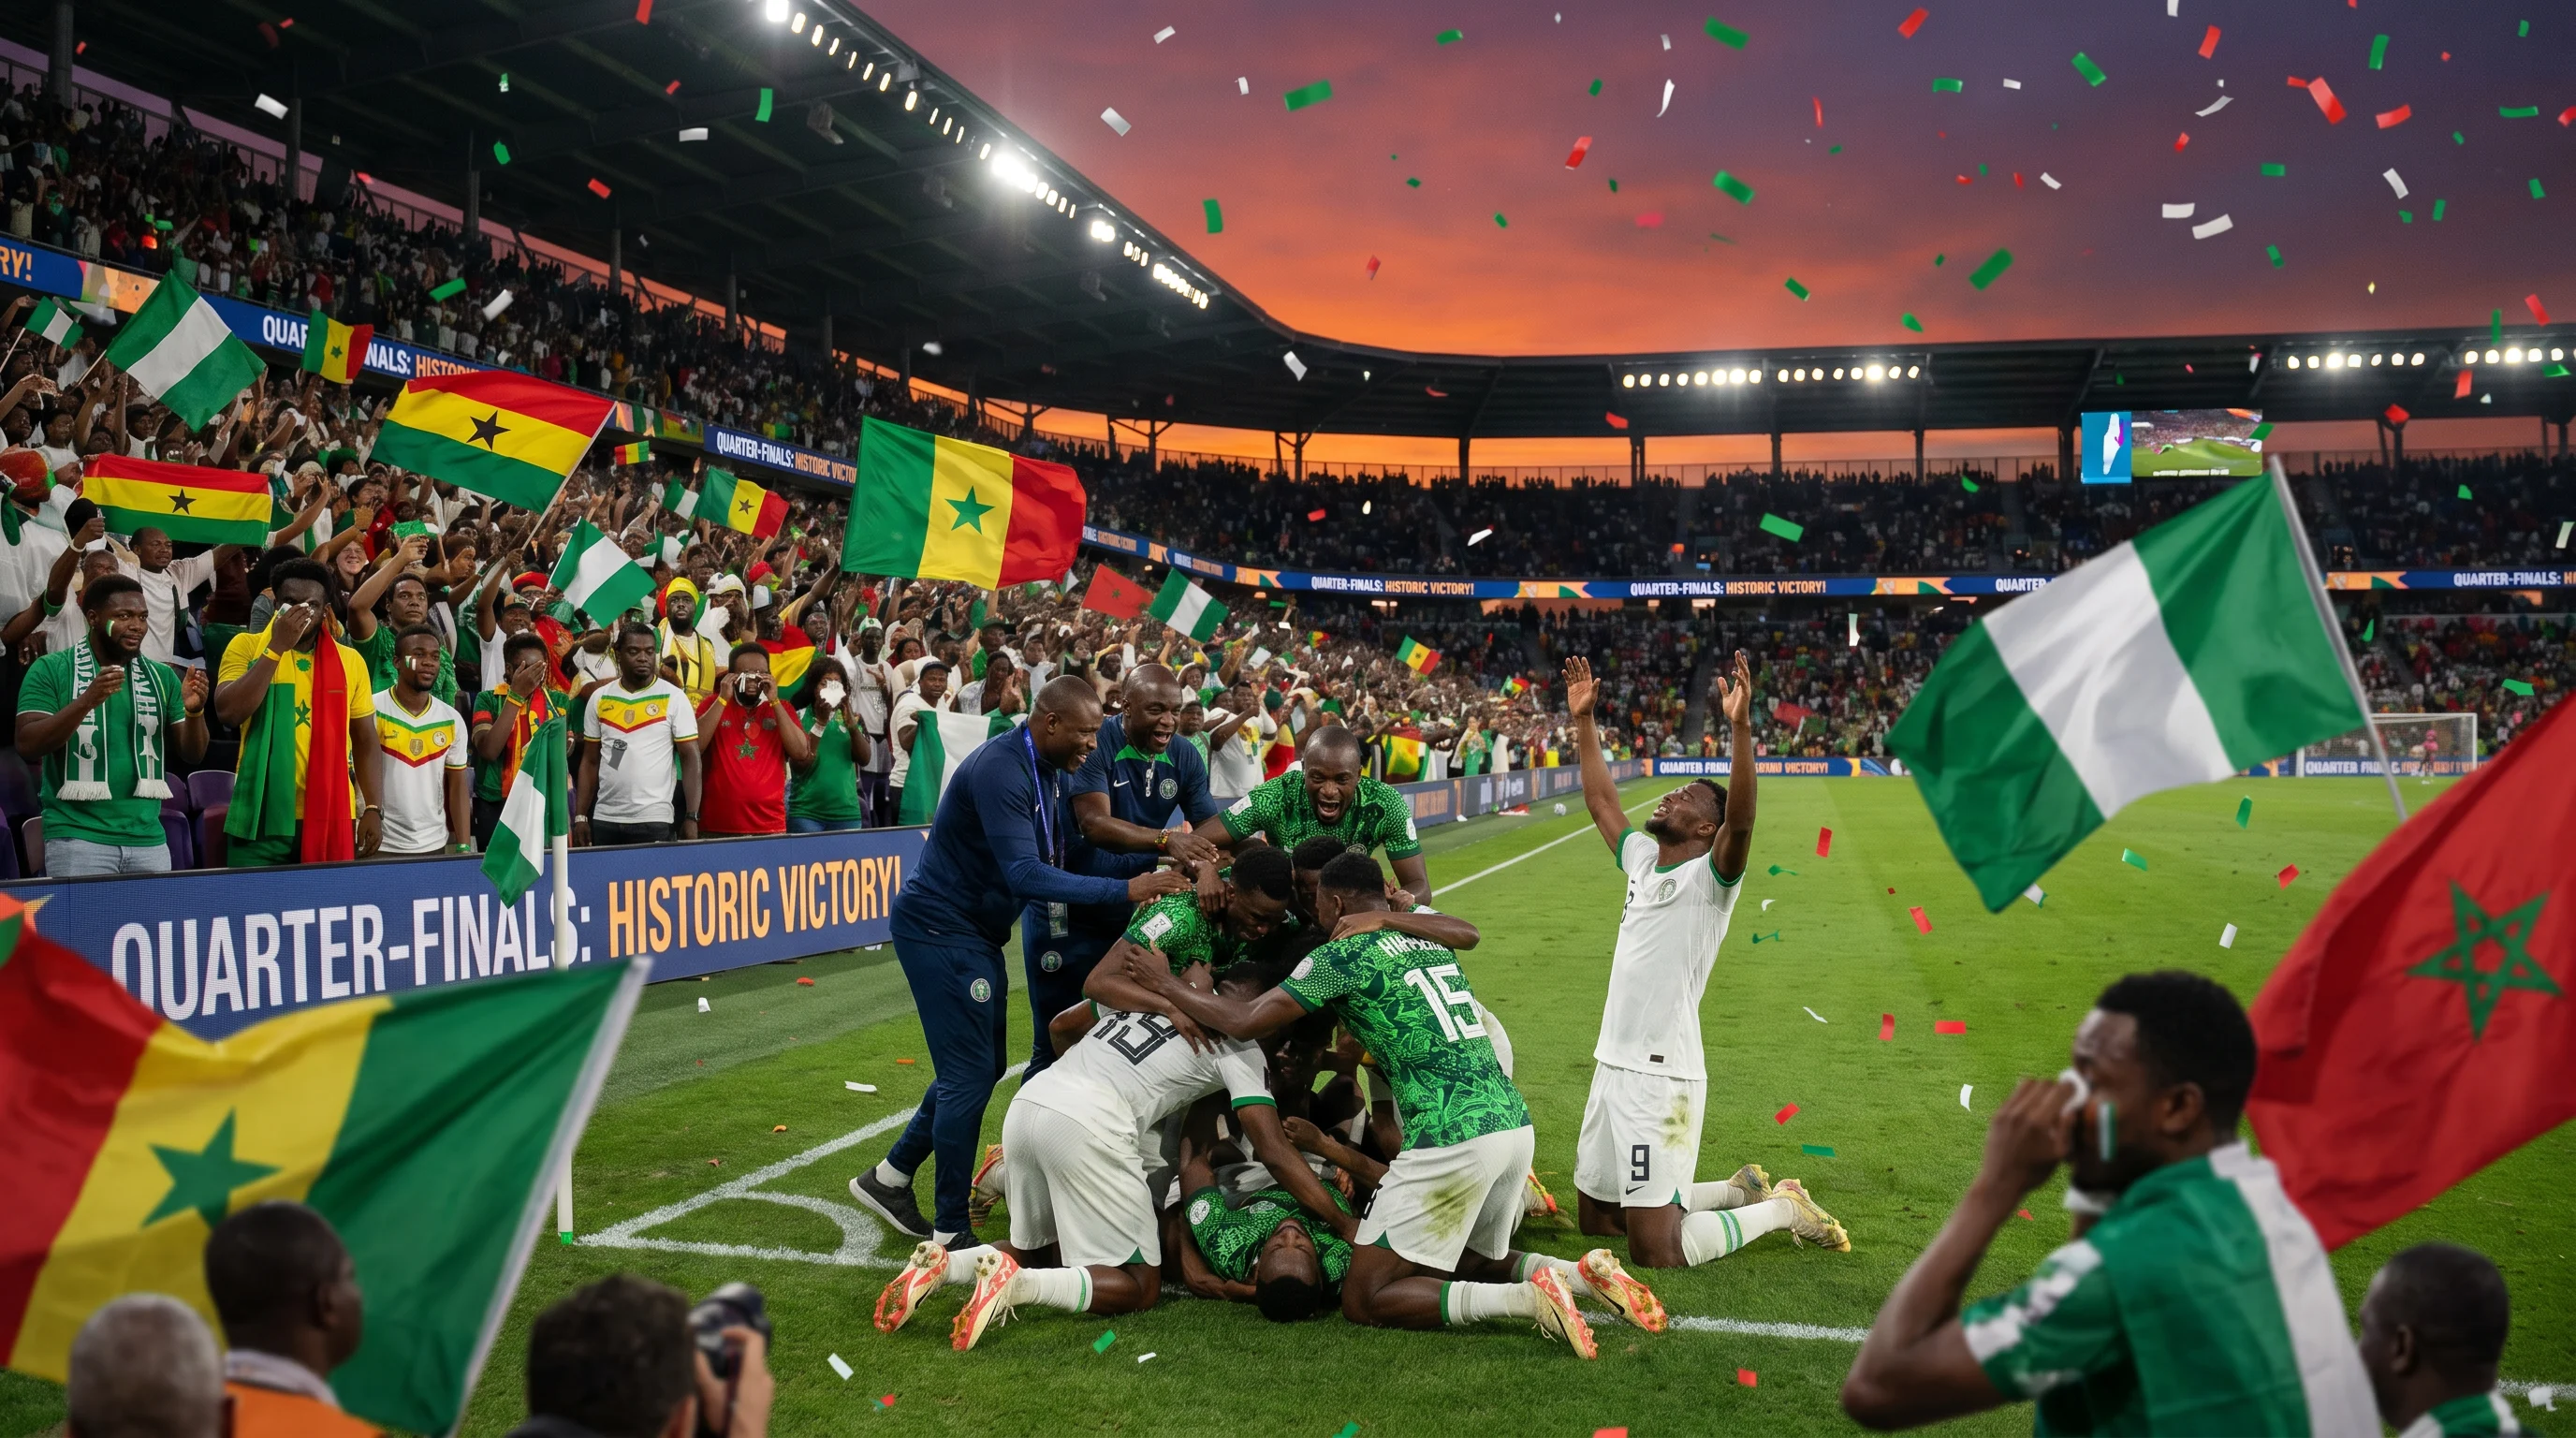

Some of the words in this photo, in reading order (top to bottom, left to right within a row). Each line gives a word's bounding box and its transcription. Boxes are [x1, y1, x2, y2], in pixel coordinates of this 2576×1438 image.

[416, 354, 479, 377] HISTO
[717, 432, 794, 468] QUARTER-FINALS:
[1311, 576, 1383, 593] QUARTER-FINALS:
[1384, 580, 1428, 594] HISTORIC
[1430, 581, 1474, 595] VICTORY!
[1630, 581, 1724, 596] QUARTER-FINALS:
[1726, 581, 1776, 594] HISTORIC
[1777, 580, 1826, 594] VICTORY!
[1995, 578, 2056, 593] QUARTER
[2453, 571, 2561, 587] QUARTER-FINALS:
[112, 887, 591, 1020] QUARTER-FINALS:
[609, 867, 770, 959] HISTORIC
[778, 855, 901, 933] VICTORY!
[1404, 962, 1488, 1043] 15
[1632, 1144, 1650, 1181] 9
